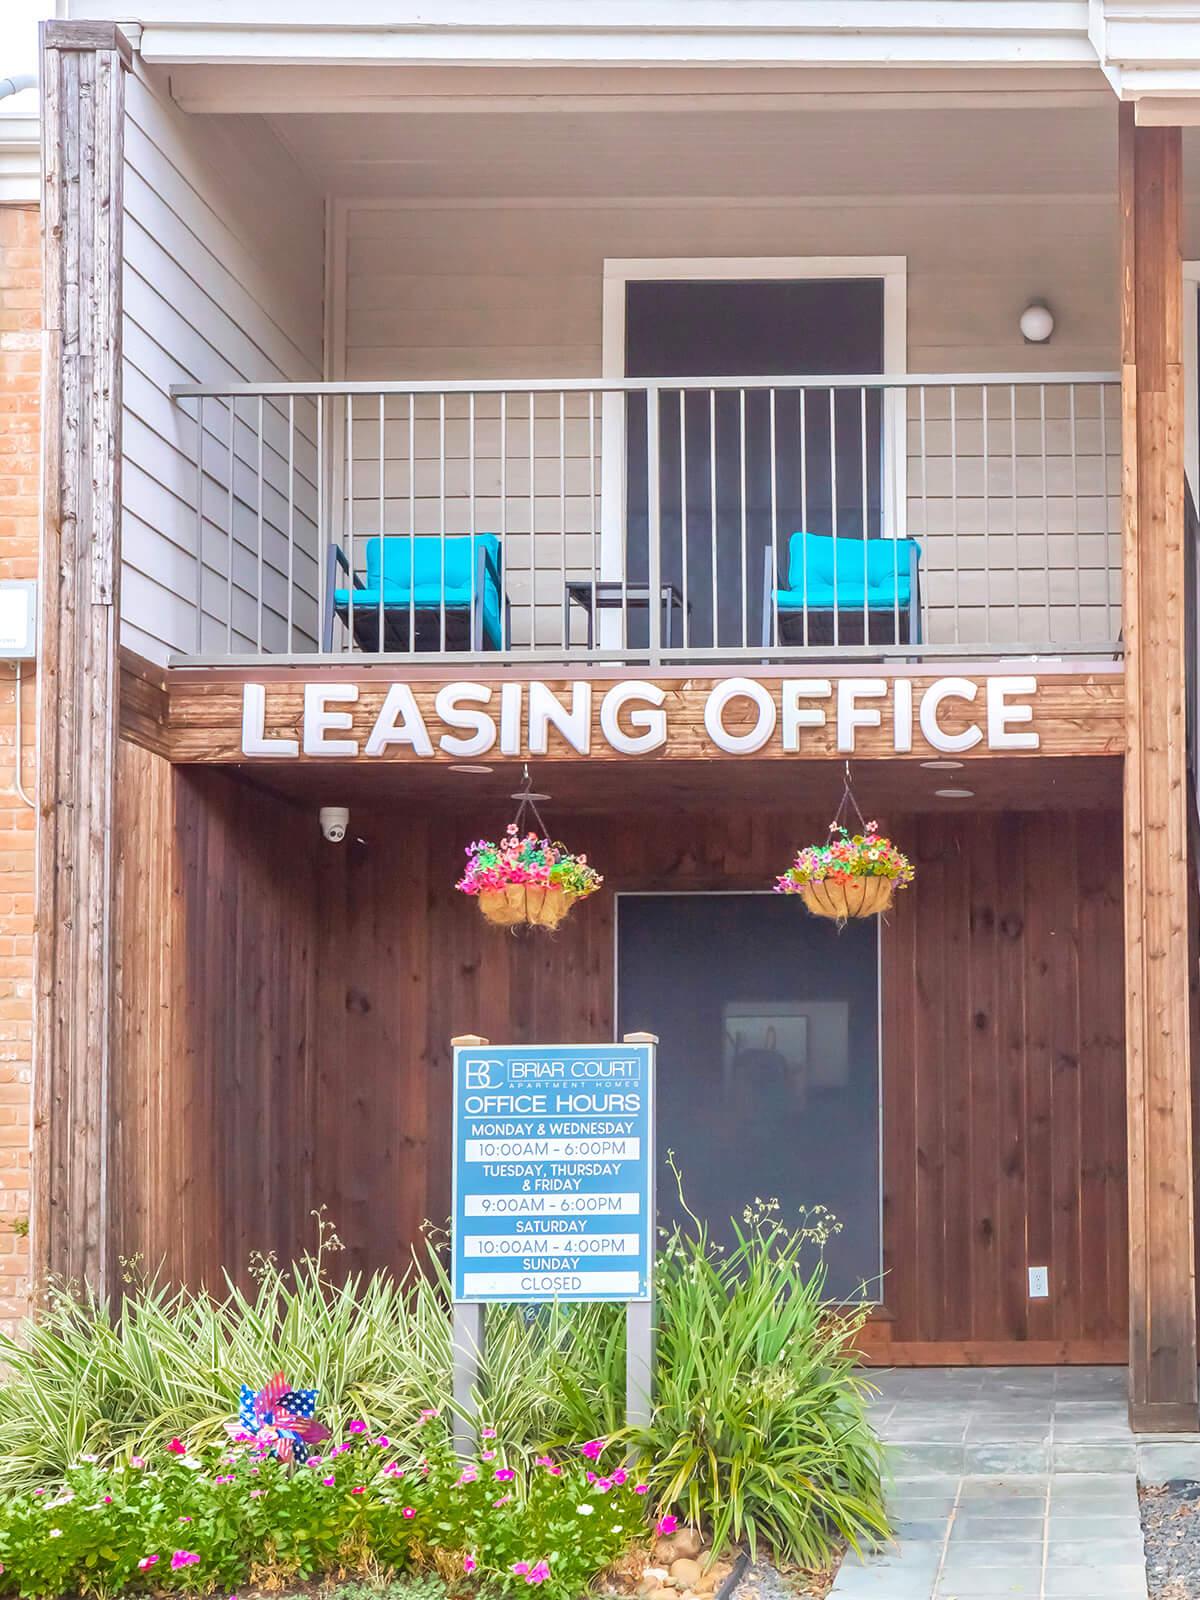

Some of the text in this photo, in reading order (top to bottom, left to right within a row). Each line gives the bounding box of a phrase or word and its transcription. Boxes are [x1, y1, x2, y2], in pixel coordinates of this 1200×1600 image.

[241, 676, 1041, 759] LEASING OFFICE
[465, 1060, 505, 1089] BC
[511, 1060, 637, 1079] BRIAR COURT
[464, 1093, 641, 1113] OFFICE HOURS
[471, 1122, 634, 1136] MONDAY & WEDNESDAY
[479, 1142, 549, 1156] 10:00AM
[564, 1141, 626, 1156] 6:00PM
[483, 1163, 622, 1178] TUESDAY, THURSDAY
[522, 1178, 582, 1192] & FRIDAY
[481, 1198, 545, 1212] 9:00AM
[560, 1197, 622, 1211] 6:00PM
[515, 1220, 588, 1233] SATURDAY
[478, 1240, 548, 1254] 10:00AM
[563, 1239, 625, 1253] 4:00PM
[522, 1258, 580, 1270] SUNDAY
[520, 1277, 582, 1291] CLOSED
